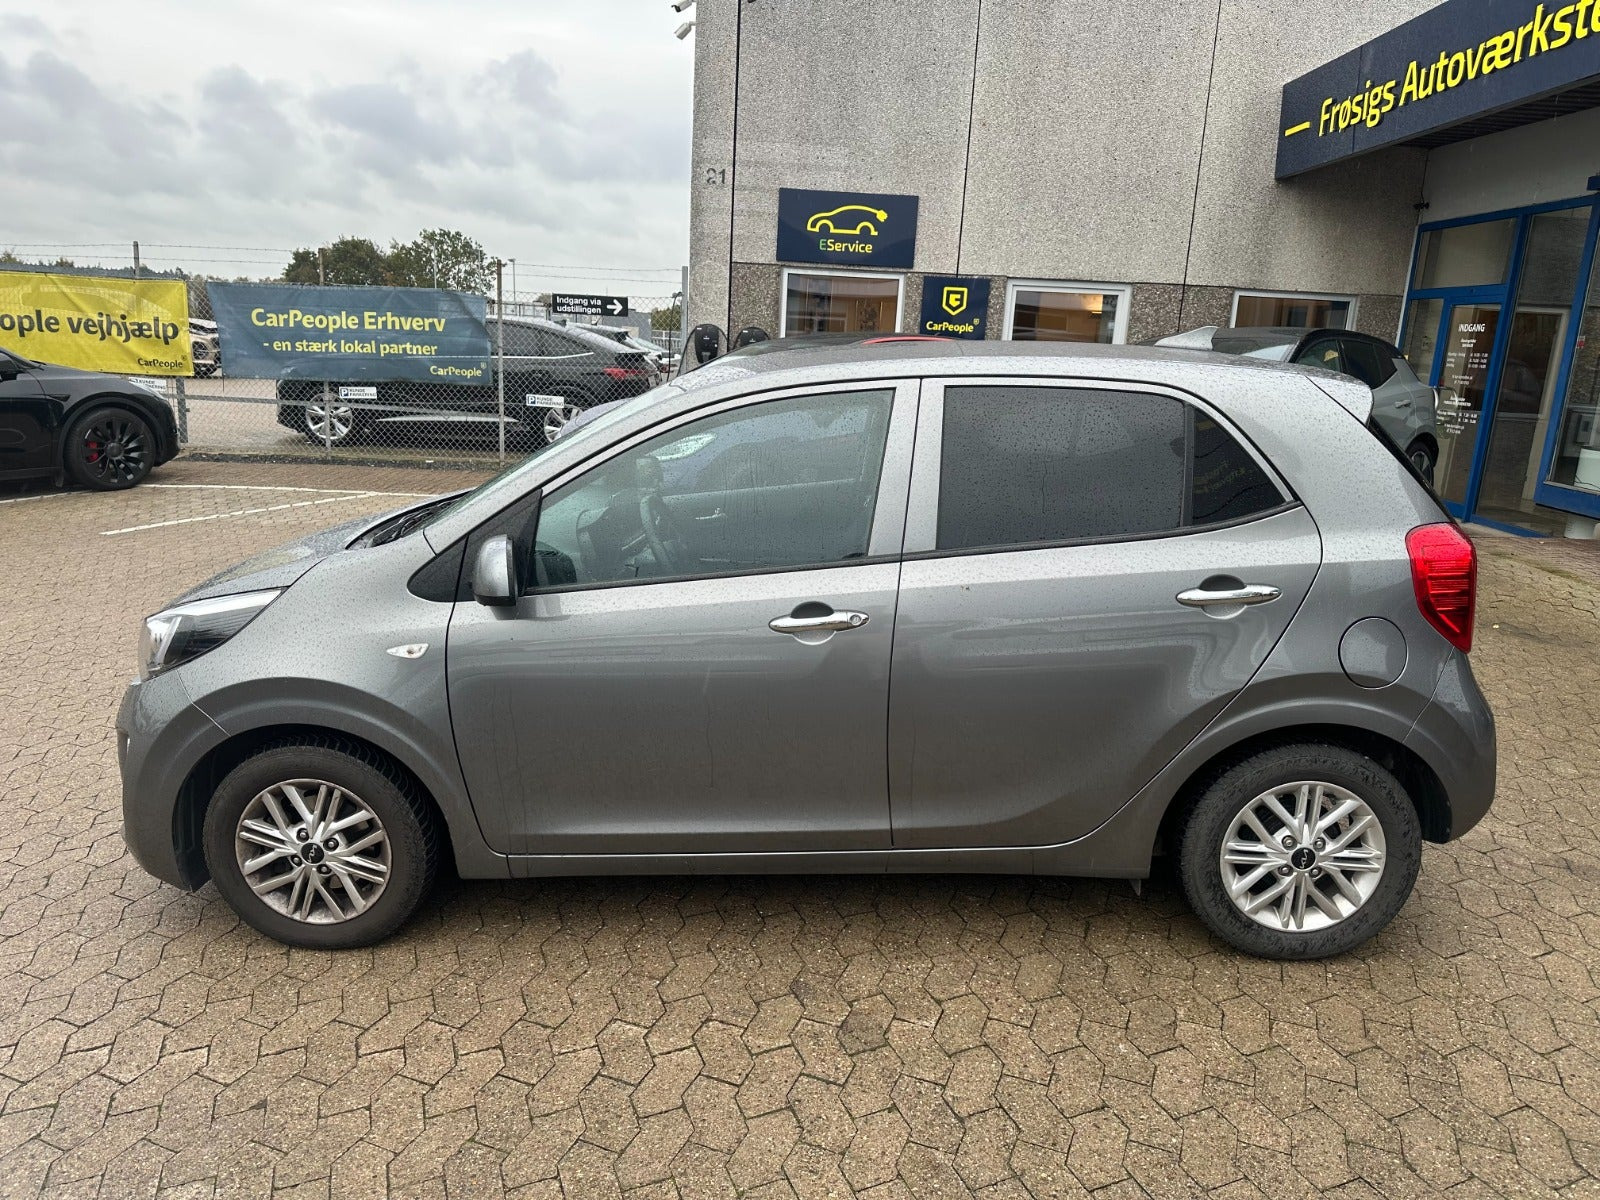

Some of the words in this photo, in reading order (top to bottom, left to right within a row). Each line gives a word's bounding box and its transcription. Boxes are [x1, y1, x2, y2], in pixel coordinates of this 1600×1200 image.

[1319, 80, 1396, 136] Frøsigs
[706, 167, 726, 185] 21
[819, 239, 873, 253] EService
[556, 296, 588, 306] Indgang
[556, 305, 602, 314] udstillingen
[0, 309, 60, 337] ople
[67, 312, 179, 345] vejhjælp
[251, 308, 359, 333] CarPeople
[363, 311, 446, 332] Erhverv
[1458, 323, 1486, 332] INDGANG
[273, 341, 291, 351] en
[295, 339, 337, 352] stærk
[340, 340, 376, 354] lokal
[380, 342, 438, 357] partner
